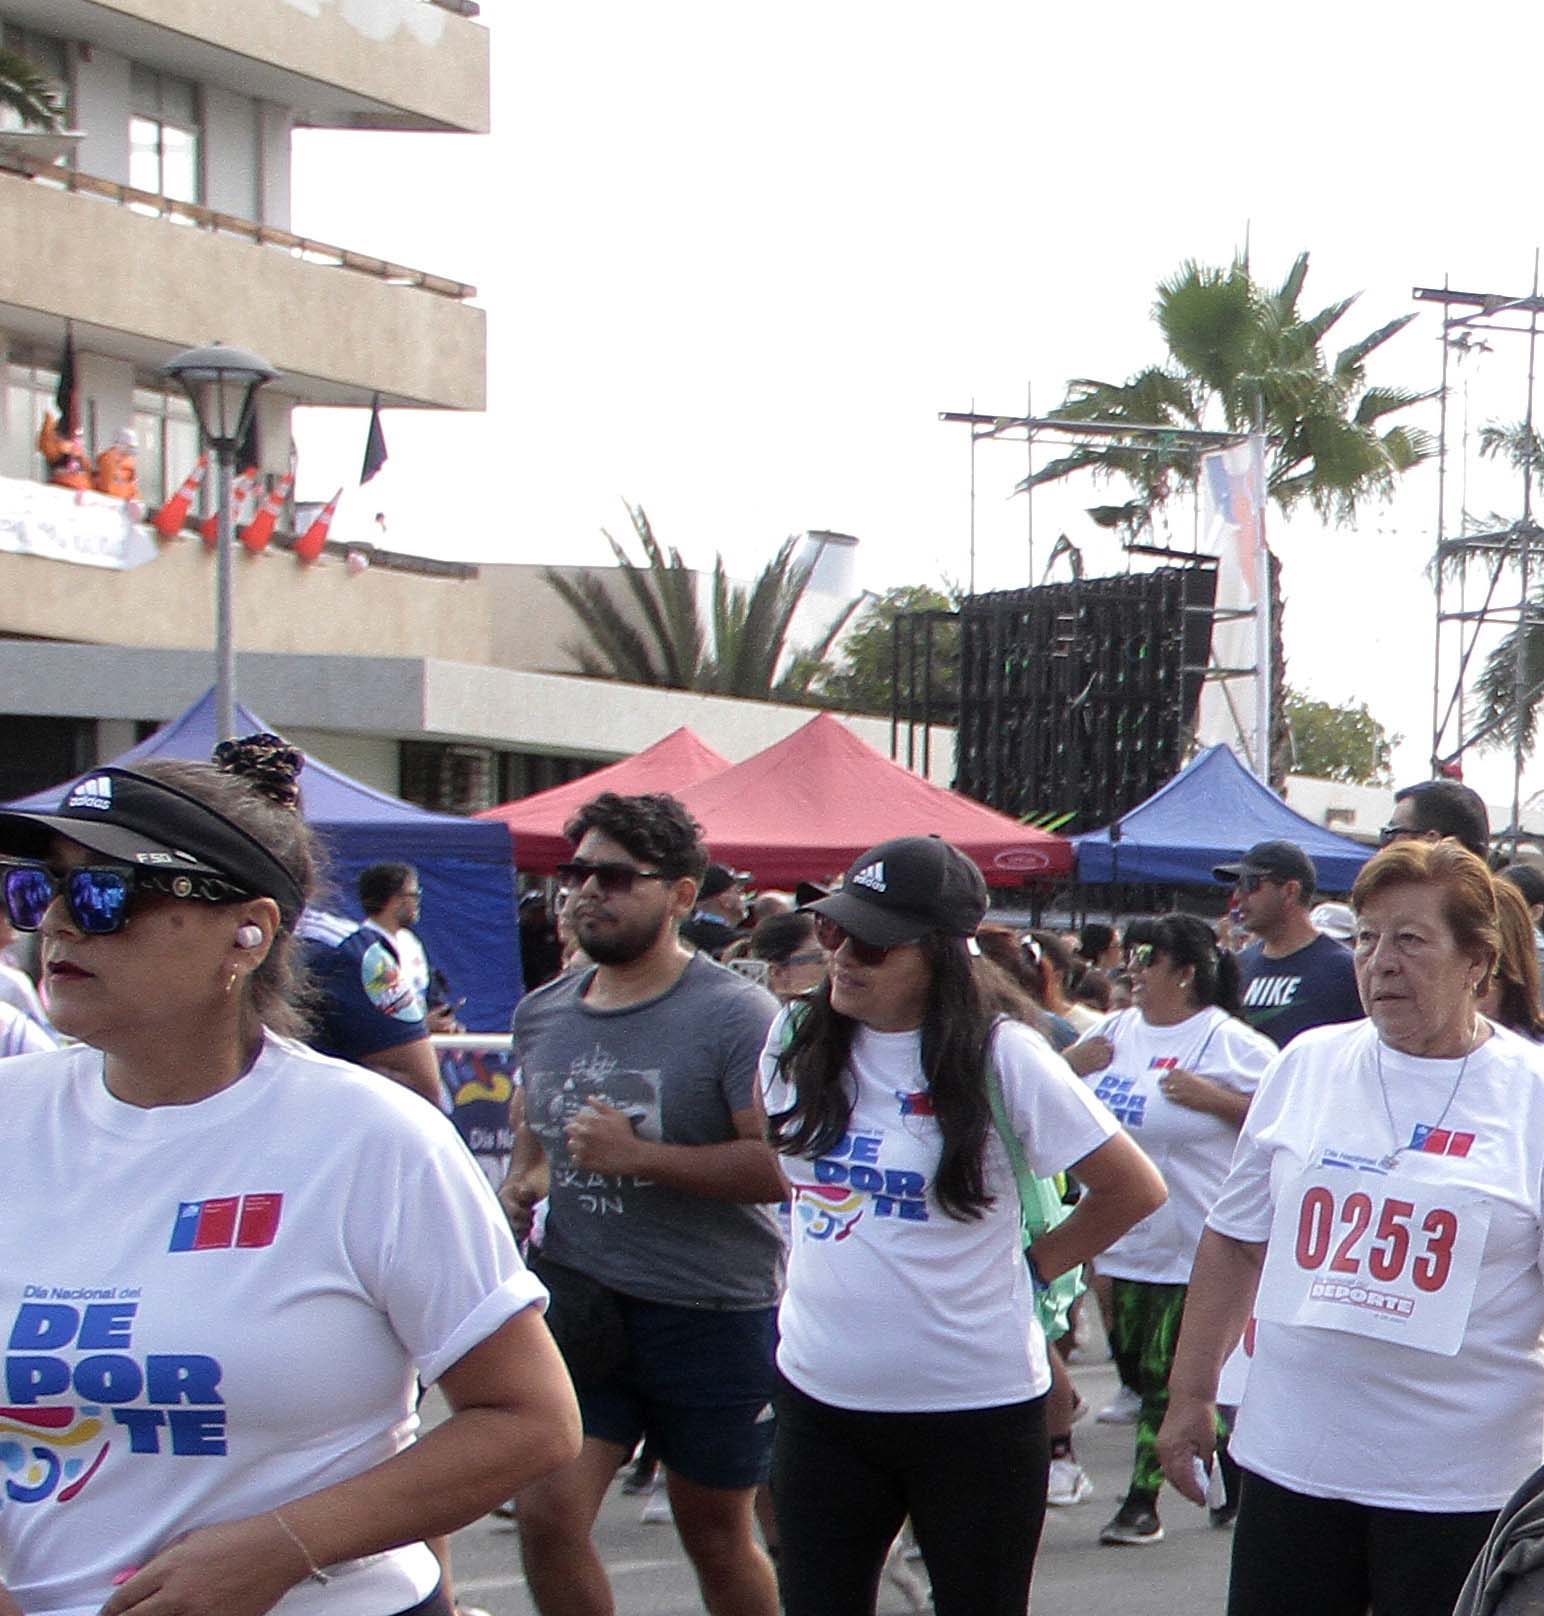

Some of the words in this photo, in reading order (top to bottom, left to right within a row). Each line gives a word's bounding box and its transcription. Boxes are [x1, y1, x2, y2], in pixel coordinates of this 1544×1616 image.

[69, 796, 112, 810] adidas
[852, 874, 889, 893] adidas
[1244, 976, 1302, 1006] NIKE
[1295, 1186, 1457, 1293] 0253
[50, 1287, 117, 1300] Nacional
[118, 1287, 143, 1299] del
[1311, 1282, 1415, 1317] DEPORTE
[8, 1302, 140, 1351] DE
[5, 1353, 227, 1405] POR
[111, 1407, 228, 1456] TE
